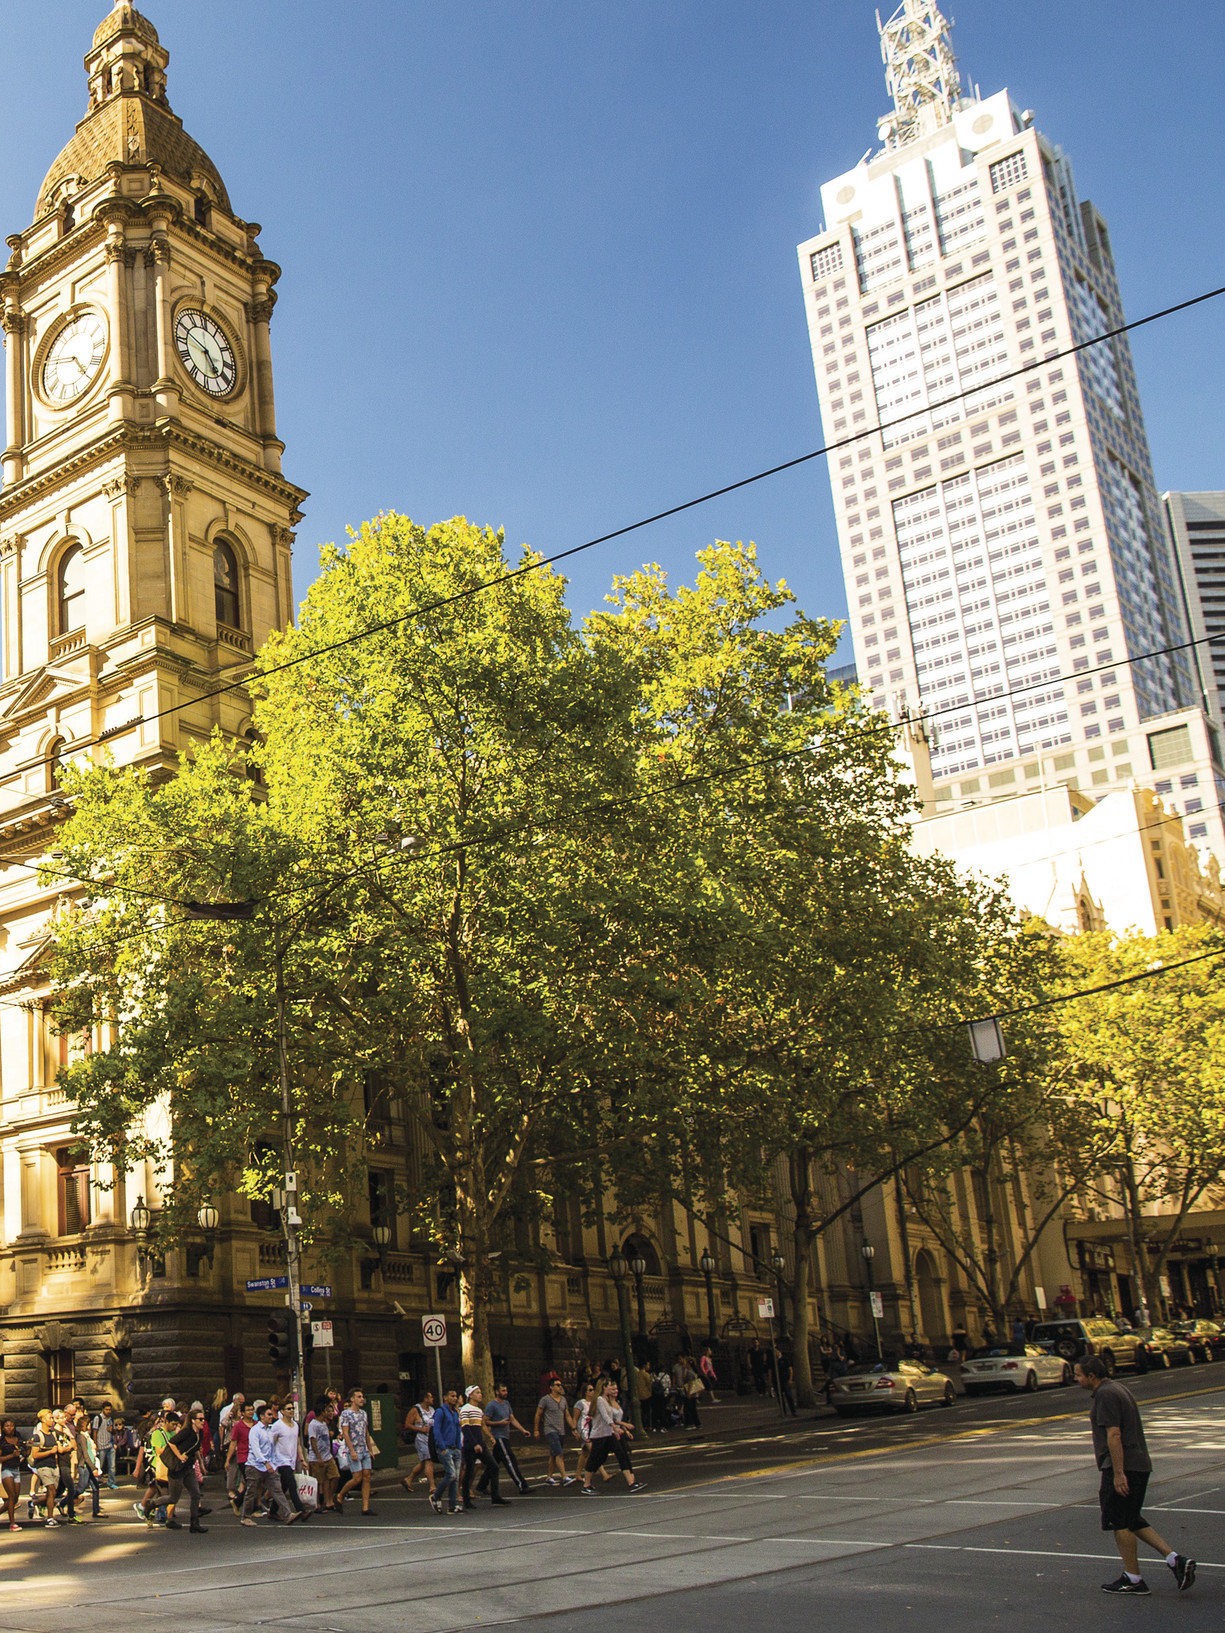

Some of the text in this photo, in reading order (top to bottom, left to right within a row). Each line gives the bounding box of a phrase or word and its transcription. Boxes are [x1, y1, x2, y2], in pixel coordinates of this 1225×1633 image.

[247, 1280, 270, 1289] Swanston
[310, 1286, 325, 1294] Collins
[426, 1324, 443, 1336] 40
